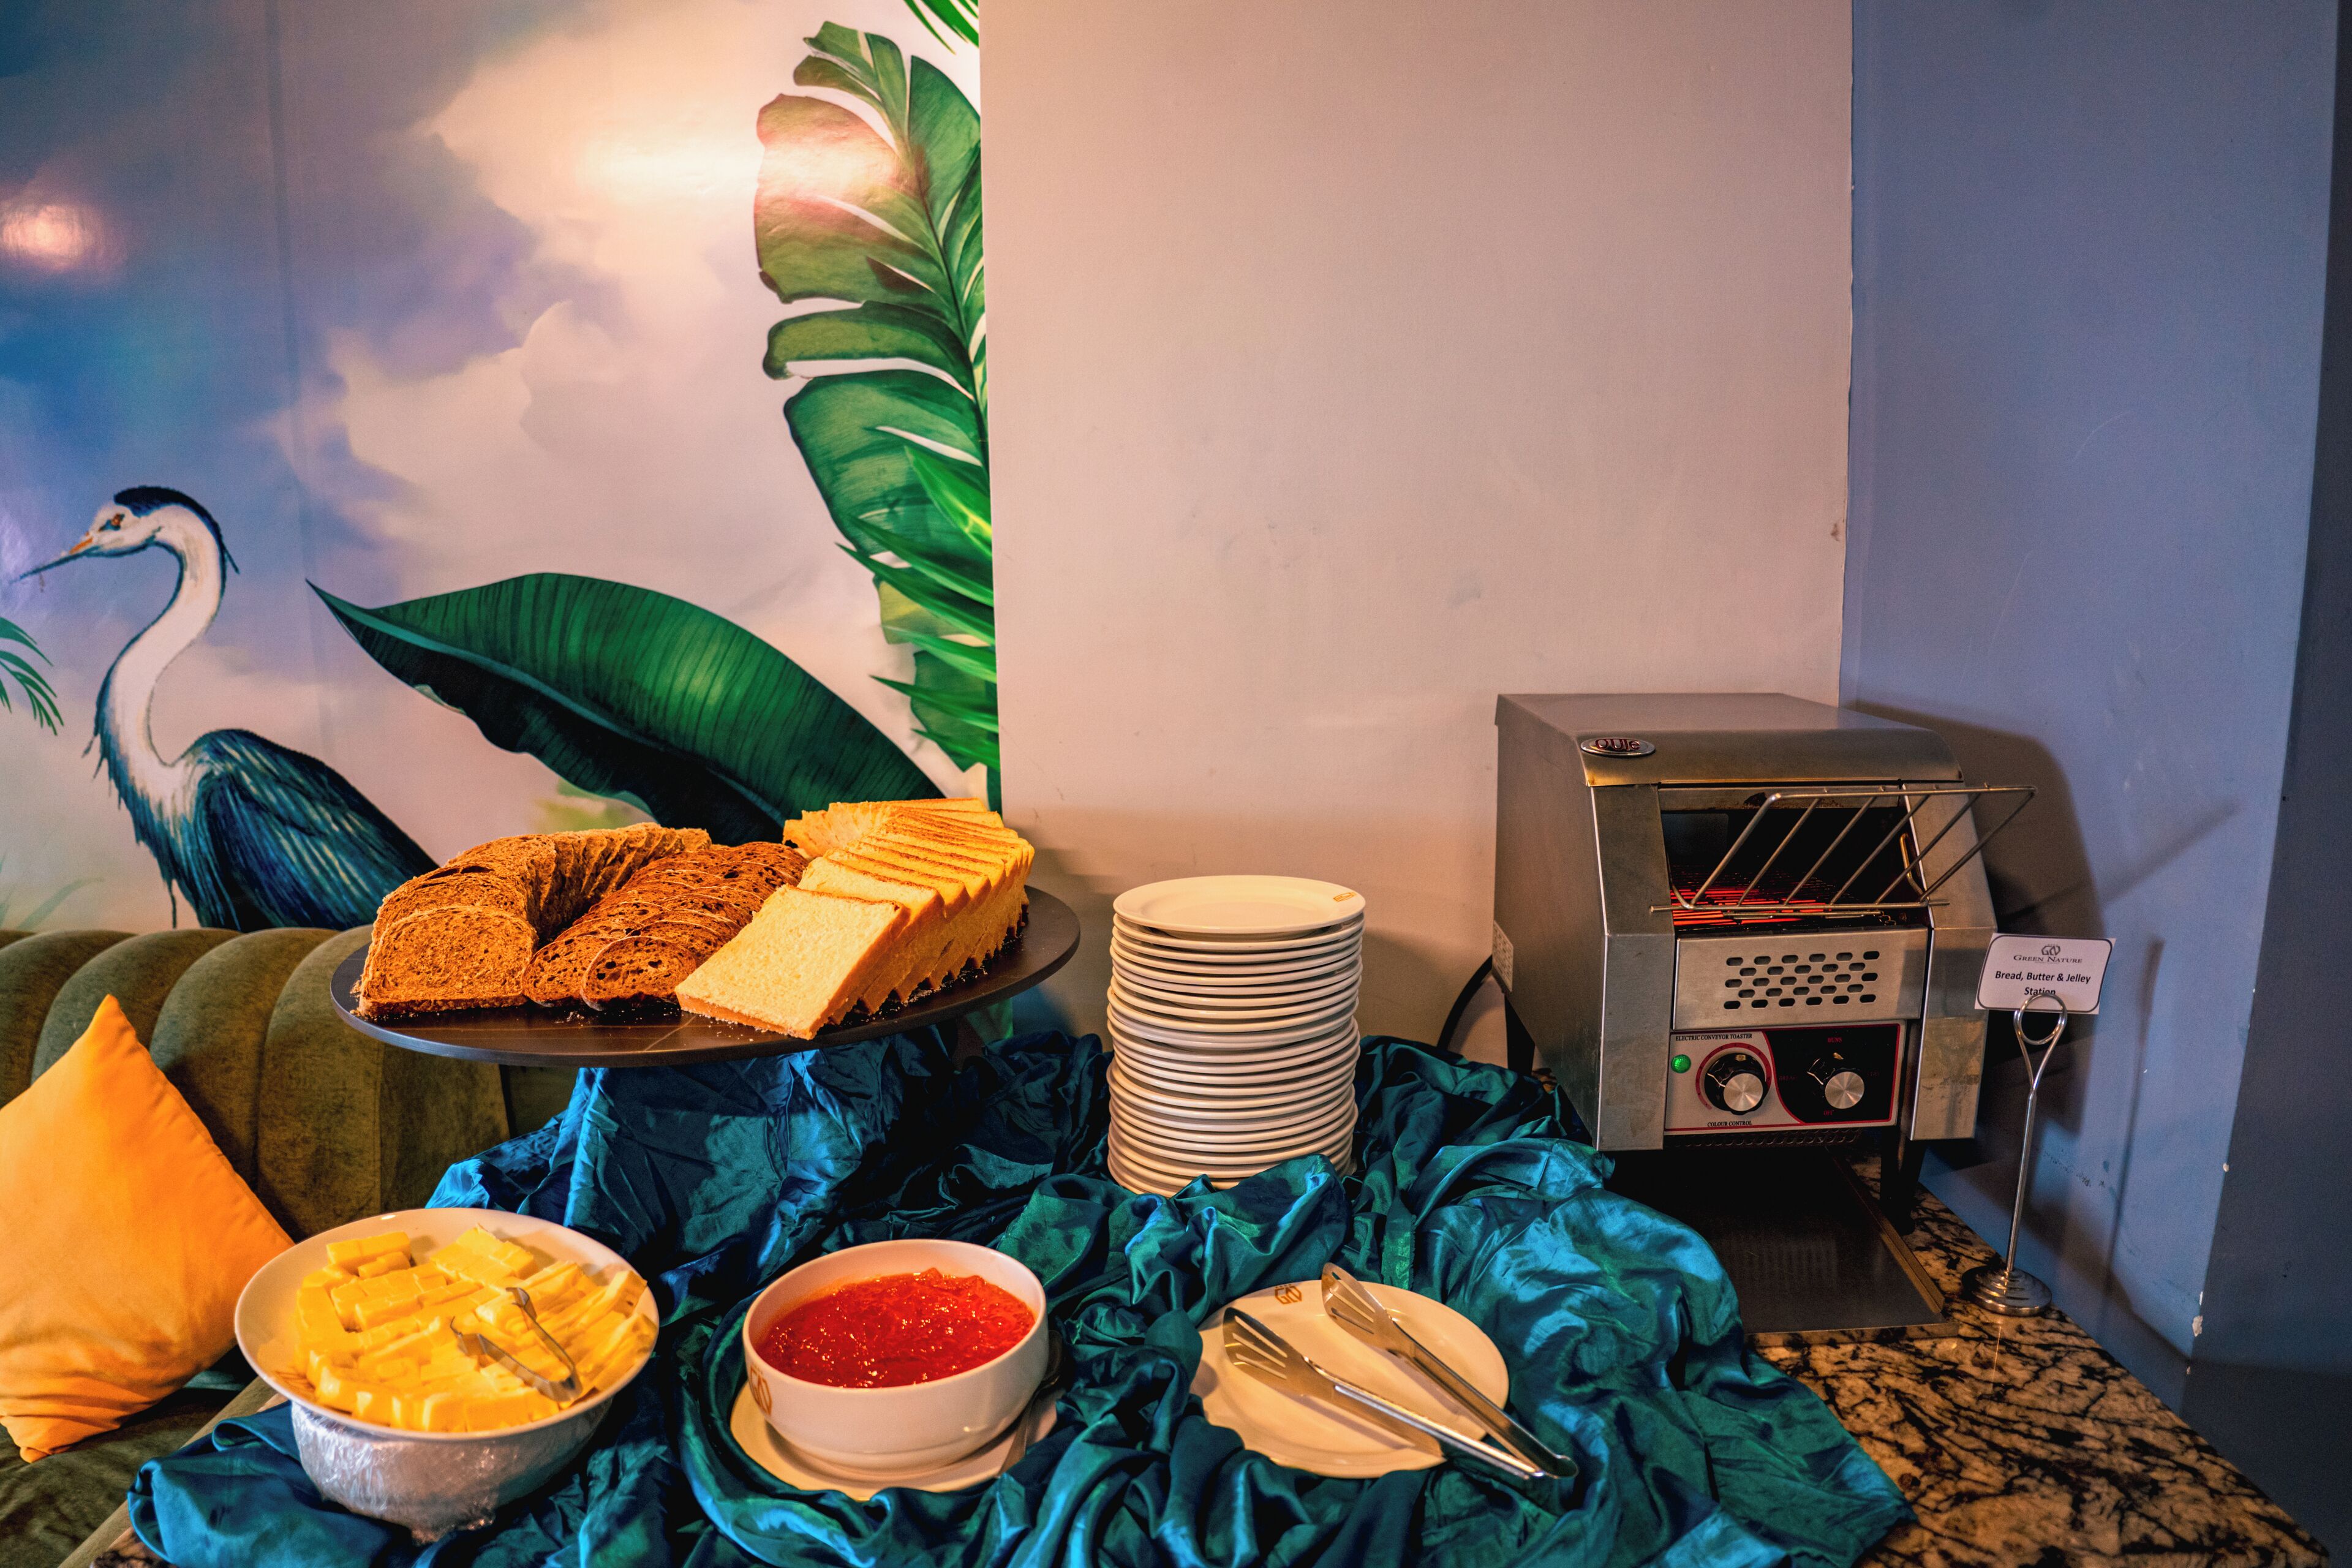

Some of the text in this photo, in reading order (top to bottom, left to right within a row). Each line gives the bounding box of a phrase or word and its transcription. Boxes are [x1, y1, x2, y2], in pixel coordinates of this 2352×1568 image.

[1995, 971, 2024, 981] Bread,
[2026, 972, 2055, 981] Butter
[2065, 974, 2091, 984] Jelley
